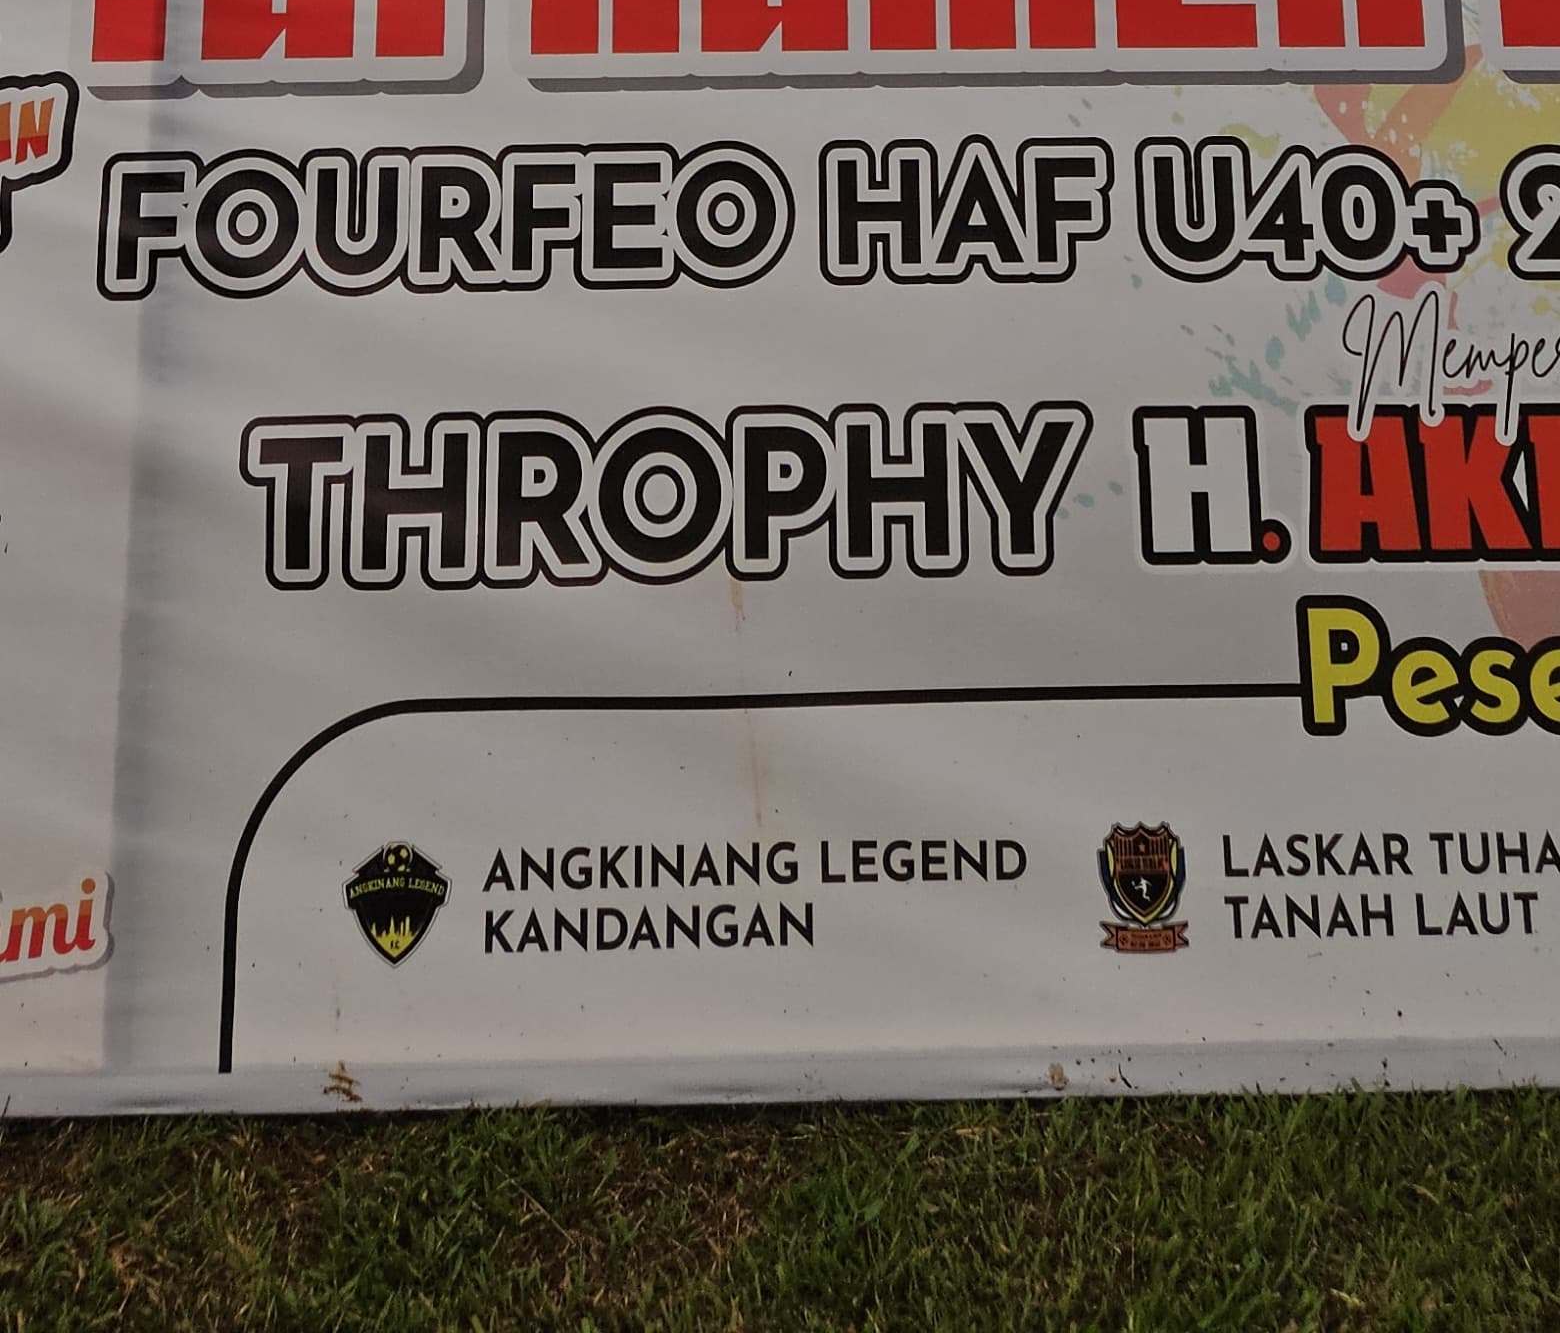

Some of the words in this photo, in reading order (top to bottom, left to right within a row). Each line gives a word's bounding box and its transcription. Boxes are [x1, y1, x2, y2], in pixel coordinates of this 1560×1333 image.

[0, 98, 55, 165] N
[107, 148, 786, 293] FOURFEO
[828, 147, 1104, 275] HAF
[1144, 145, 1471, 273] U40+
[1343, 290, 1560, 436] Mempe
[250, 409, 1082, 581] THROPHY
[1138, 411, 1286, 559] H.
[482, 841, 799, 893] ANGKINANG
[820, 839, 1028, 884] LEGEND
[1222, 831, 1414, 878] LASKAR
[1429, 829, 1560, 875] TUHA
[350, 877, 406, 899] ANGKINANG
[408, 877, 445, 896] LEGEND
[1223, 891, 1395, 939] TANAH
[1415, 889, 1538, 936] LAUT
[0, 877, 96, 963] mi
[484, 900, 814, 954] KANDANGAN
